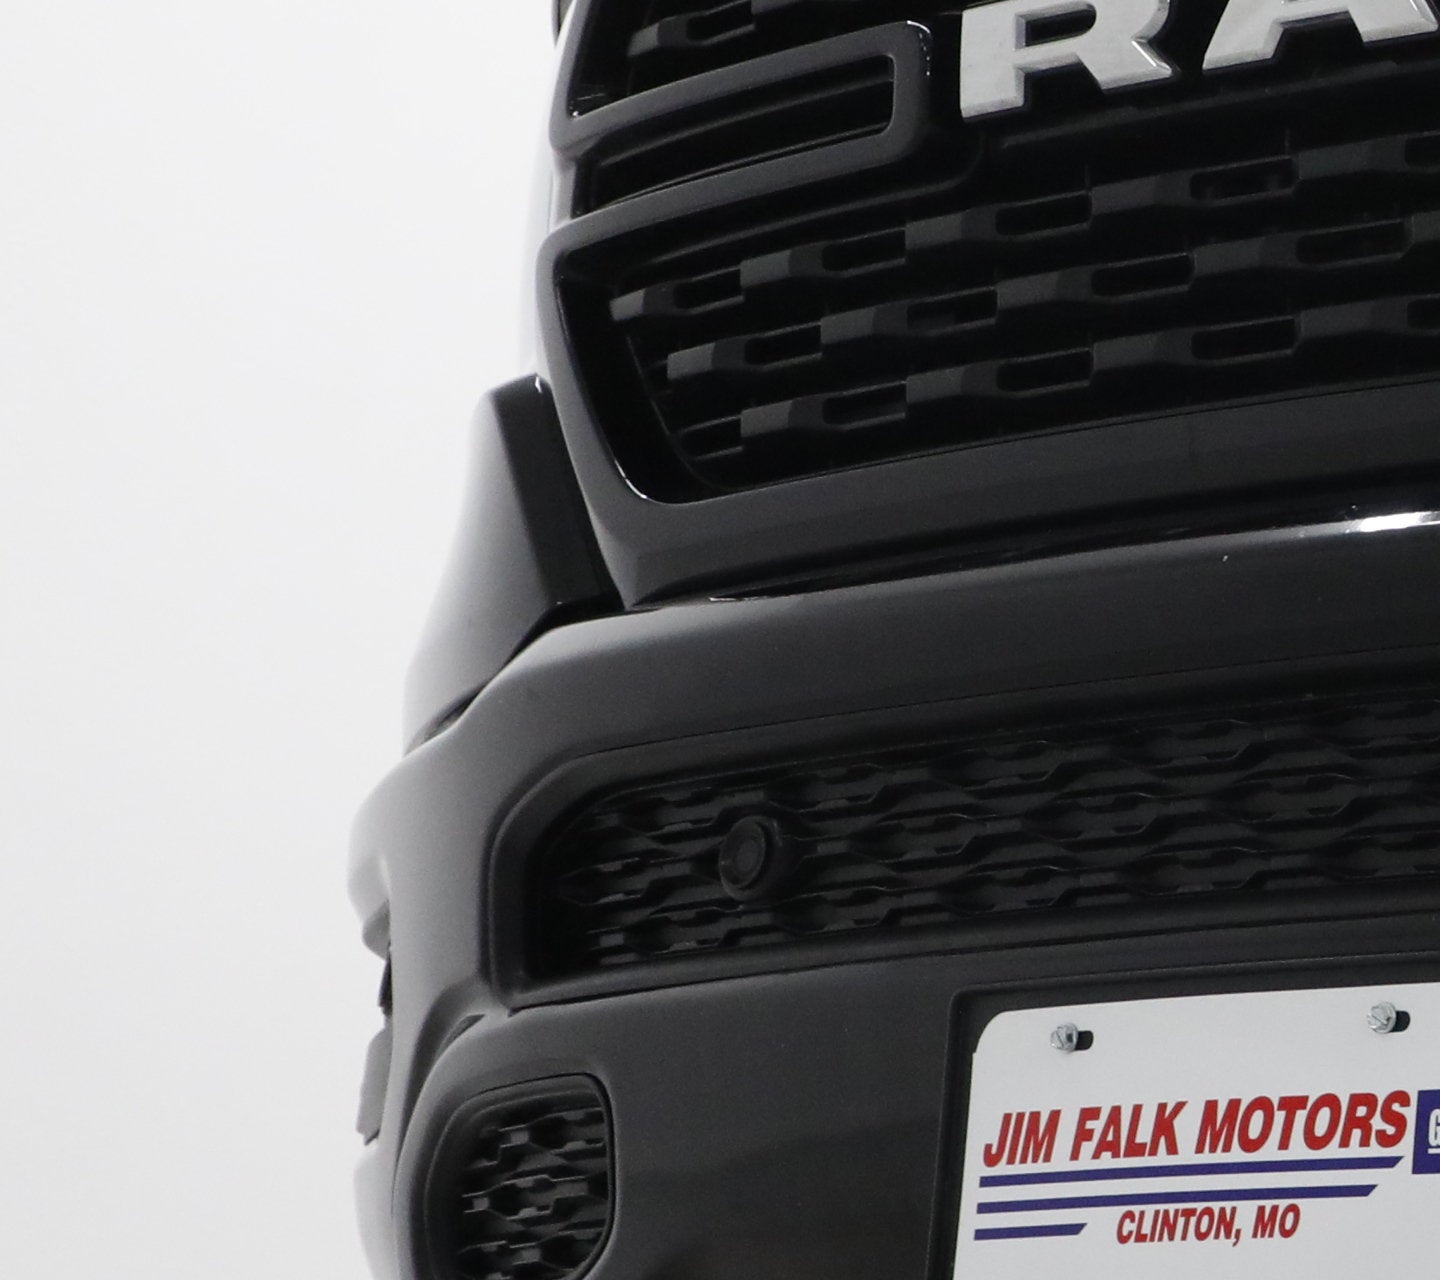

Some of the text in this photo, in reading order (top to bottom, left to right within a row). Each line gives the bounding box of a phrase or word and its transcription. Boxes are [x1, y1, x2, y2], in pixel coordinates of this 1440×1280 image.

[983, 1089, 1411, 1167] JIM FALK MOTORS
[1116, 1203, 1301, 1247] CLINTON, MO
